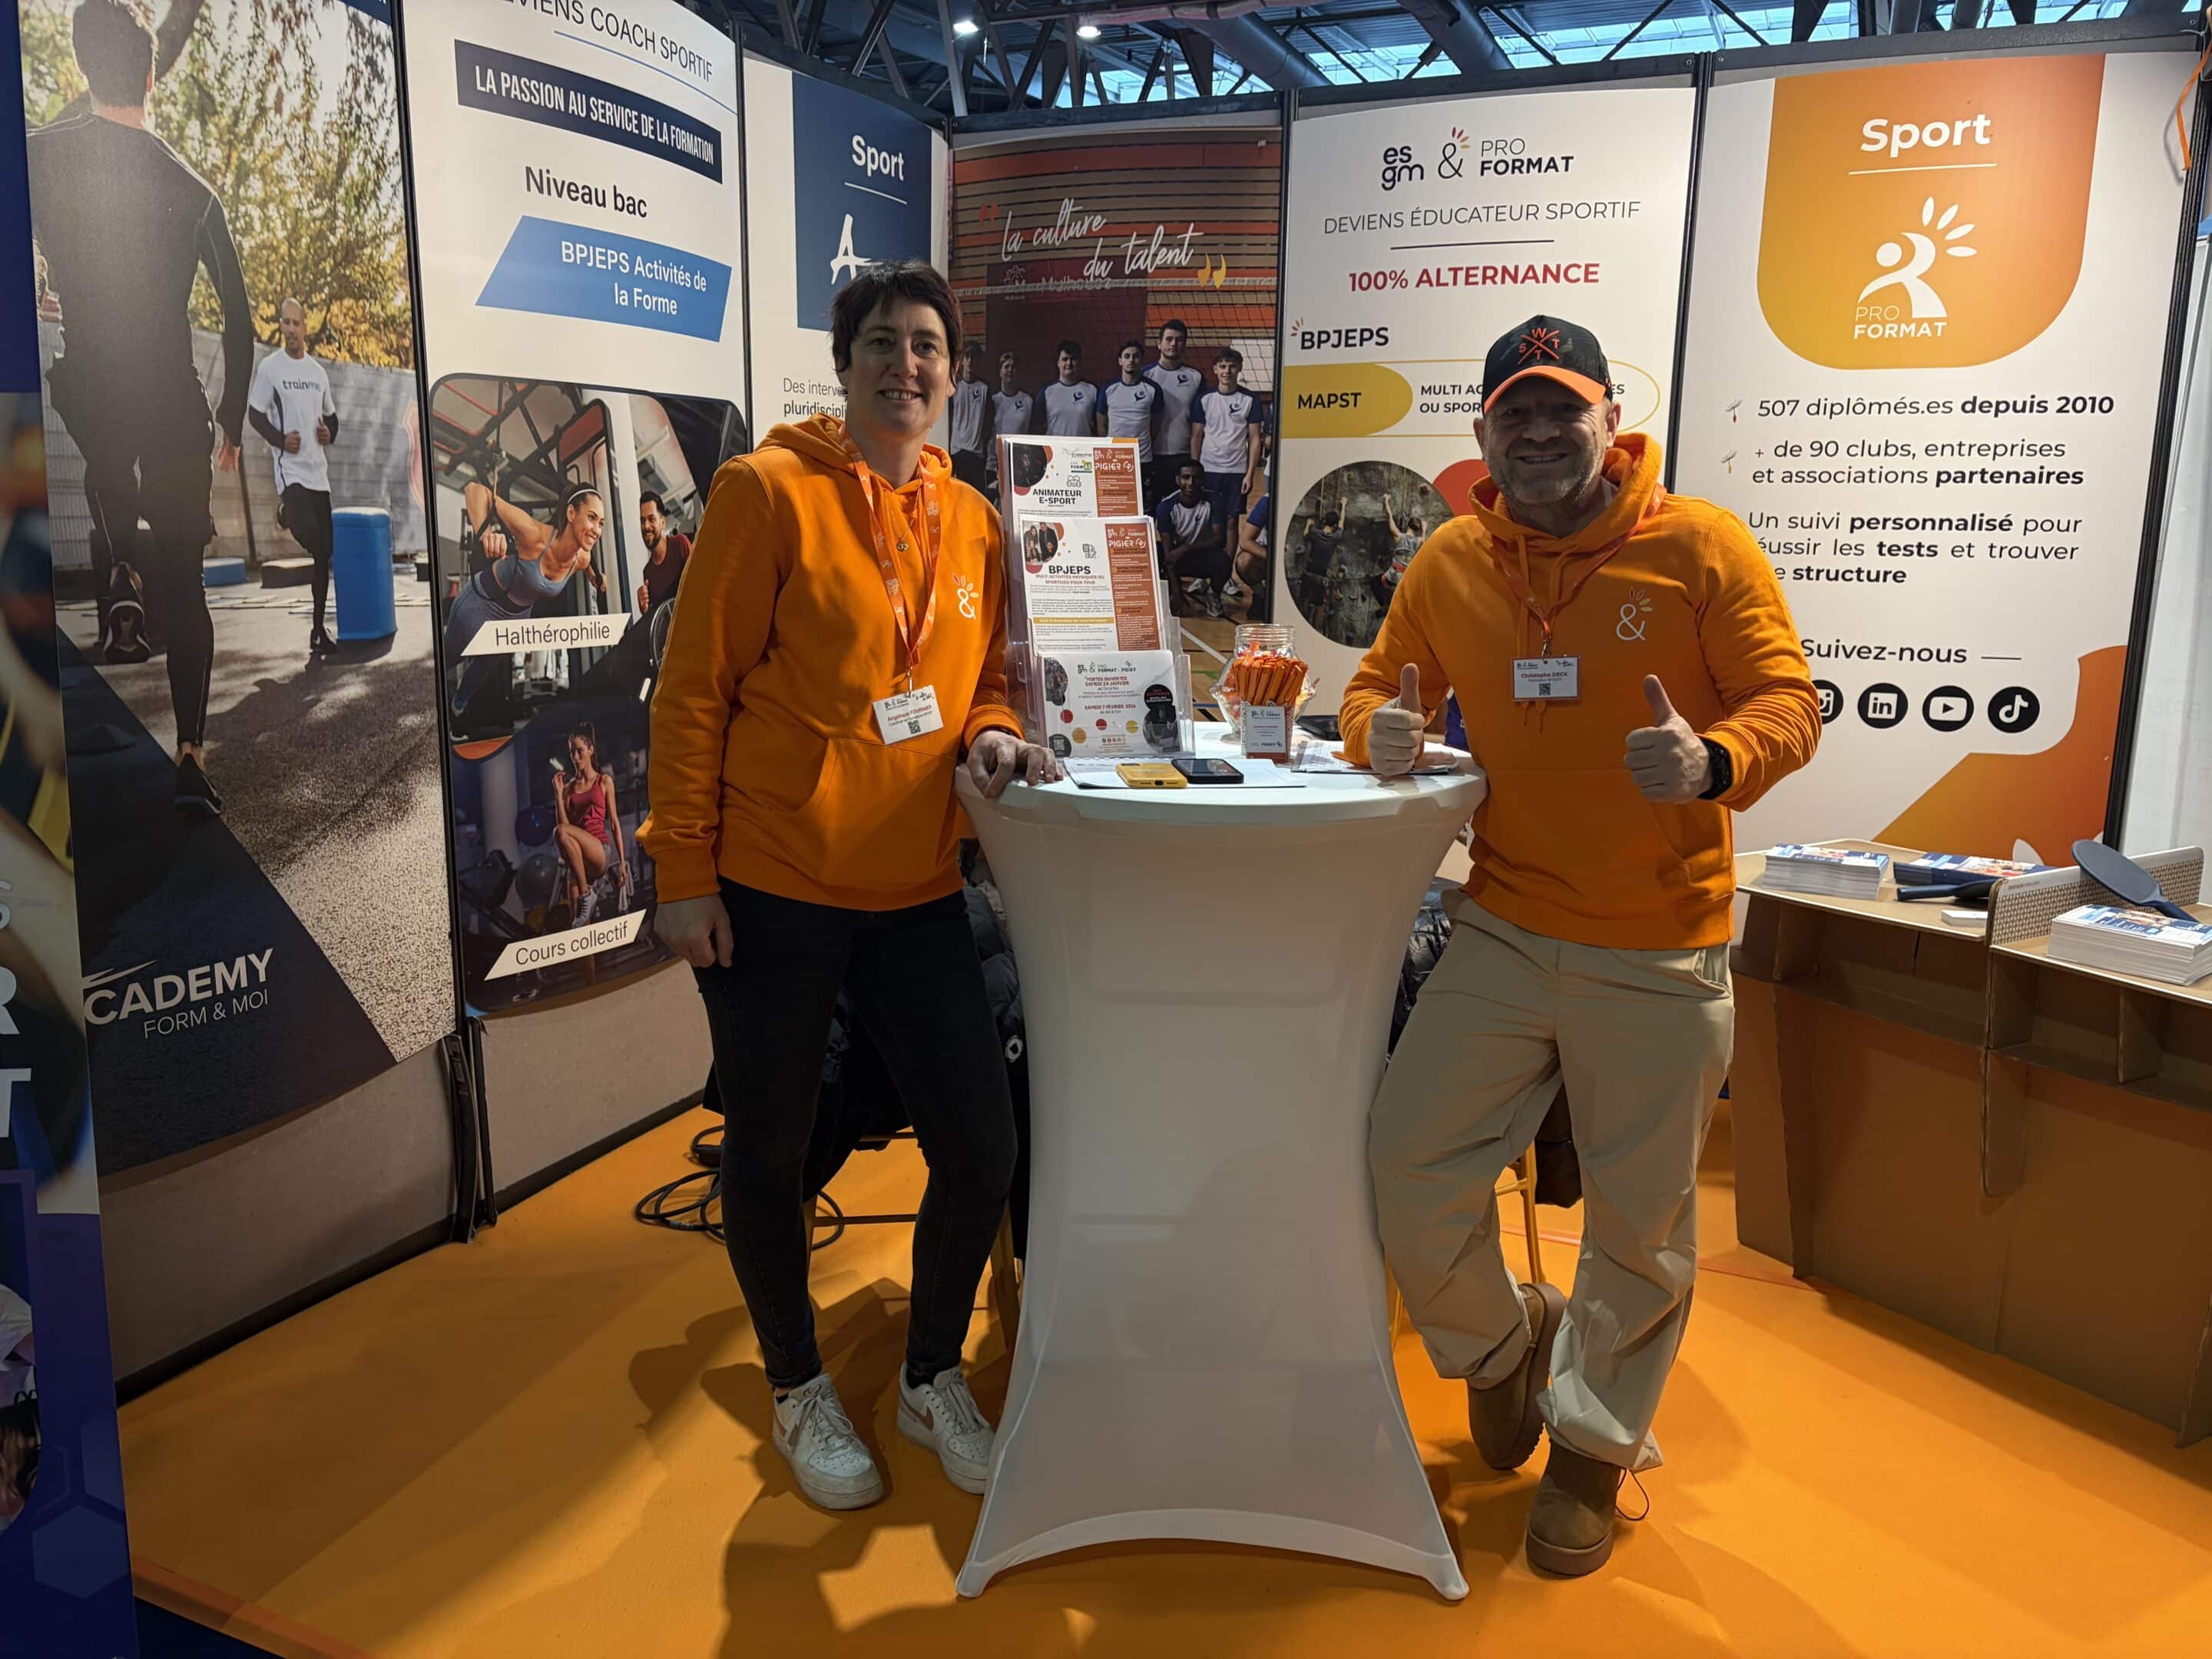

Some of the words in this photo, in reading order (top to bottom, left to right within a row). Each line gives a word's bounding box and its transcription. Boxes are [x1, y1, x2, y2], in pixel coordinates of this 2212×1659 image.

[591, 7, 656, 54] COACH
[661, 36, 712, 82] SPORTIF
[475, 65, 498, 95] LA
[501, 71, 565, 111] PASSION
[568, 91, 586, 118] AU
[590, 96, 638, 134] SERVICE
[641, 115, 655, 140] DE
[657, 121, 669, 145] LA
[671, 126, 714, 165] FORMATION
[1859, 113, 1992, 157] Sport
[852, 135, 905, 182] Sport
[1383, 146, 1412, 164] es
[1482, 138, 1525, 157] PRO
[1381, 164, 1425, 191] gm
[1480, 156, 1575, 177] FORMAT
[525, 166, 606, 208] Niveau
[613, 185, 647, 218] bac
[1033, 197, 1107, 247] culture
[1324, 212, 1404, 234] DEVIENS
[1410, 204, 1539, 227] ÉDUCATEUR
[1545, 200, 1641, 221] SPORTIF
[1084, 238, 1113, 282] du
[1121, 223, 1205, 274] talent
[561, 240, 630, 273] BPJEPS
[634, 255, 691, 288] Activités
[694, 270, 707, 292] de
[1349, 269, 1409, 292] 100%
[1415, 263, 1601, 289] ALTERNANCE
[614, 282, 628, 306] la
[633, 286, 677, 315] Forme
[1855, 305, 1899, 321] PRO
[1300, 326, 1389, 350] BPJEPS
[1853, 321, 1948, 339] FORMAT
[783, 377, 806, 394] Des
[1420, 384, 1462, 396] MULTI
[1297, 392, 1362, 409] MAPST
[1420, 403, 1439, 413] OU
[1757, 399, 1800, 417] 507
[1806, 396, 1953, 420] diplômés.es
[1961, 396, 2049, 419] depuis
[2055, 396, 2115, 414] 2010
[1773, 439, 1803, 458] de
[1809, 439, 1839, 458] 90
[1846, 439, 1917, 462] clubs,
[1924, 441, 2066, 462] entreprises
[1752, 469, 1774, 485] et
[1780, 466, 1929, 485] associations
[1935, 467, 2085, 488] partenaires
[1032, 488, 1082, 497] ANIMATEUR
[1749, 512, 1778, 529] Un
[1787, 512, 1840, 530] suivi
[1849, 513, 2013, 534] personnalisé
[2023, 515, 2082, 536] pour
[1757, 537, 1821, 555] éussir
[1833, 538, 1865, 556] les
[1877, 539, 1939, 558] tests
[1950, 542, 1975, 559] et
[1988, 543, 2078, 560] trouver
[1048, 565, 1091, 575] BPJEPS
[1793, 565, 1906, 583] structure
[495, 622, 610, 647] Halthérophilie
[1800, 638, 1967, 664] Suivez-nous
[515, 942, 566, 965] Cours
[571, 921, 628, 952] collectif
[84, 948, 273, 1025] CADEMY
[143, 1006, 207, 1039] FORM
[213, 1002, 226, 1021] &
[233, 989, 269, 1015] MOI
